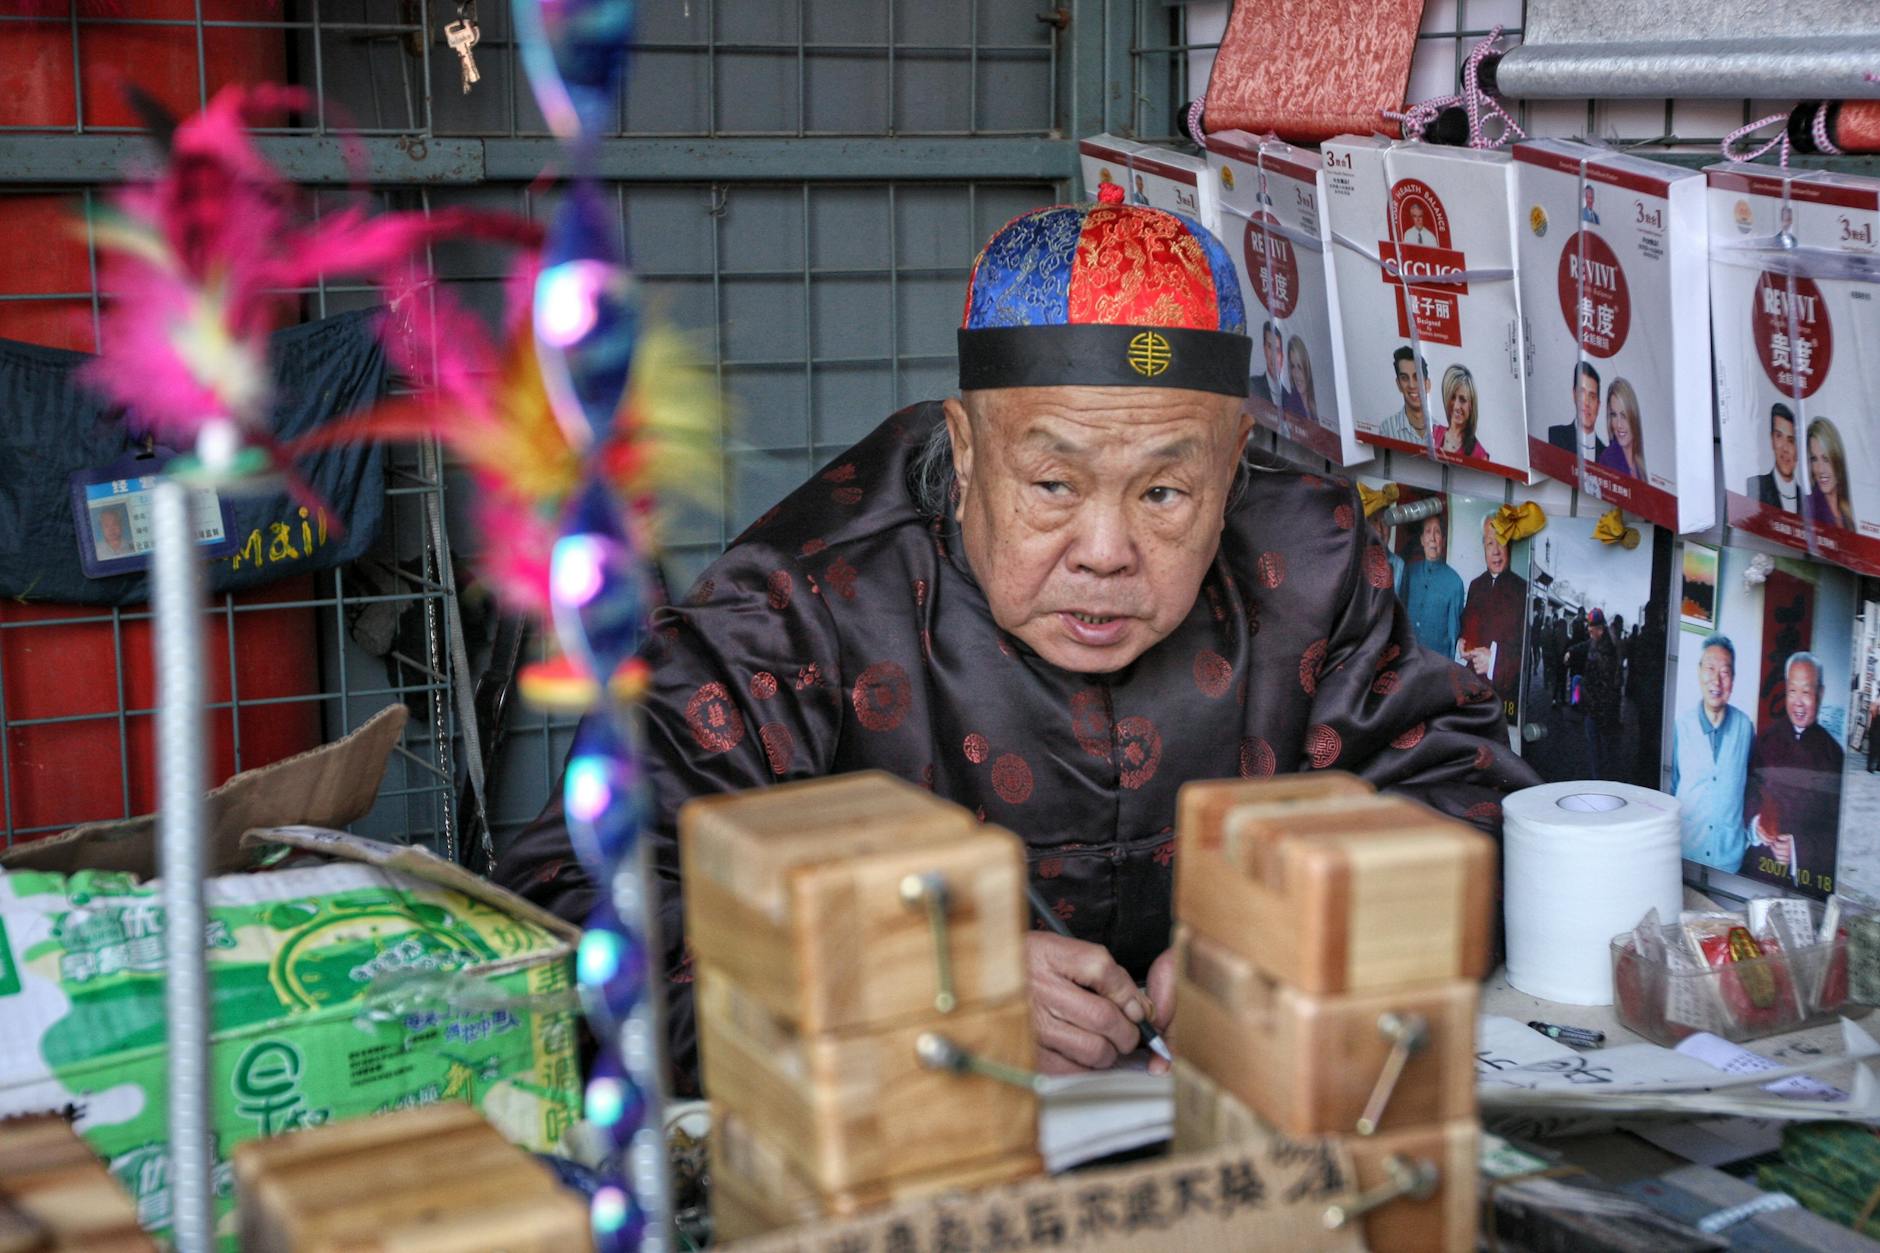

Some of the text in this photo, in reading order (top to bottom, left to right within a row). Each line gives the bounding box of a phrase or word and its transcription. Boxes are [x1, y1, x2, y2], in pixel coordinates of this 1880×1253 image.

[1396, 184, 1422, 199] HEALTH
[1424, 191, 1446, 232] BALANCE
[1816, 874, 1832, 893] 18
